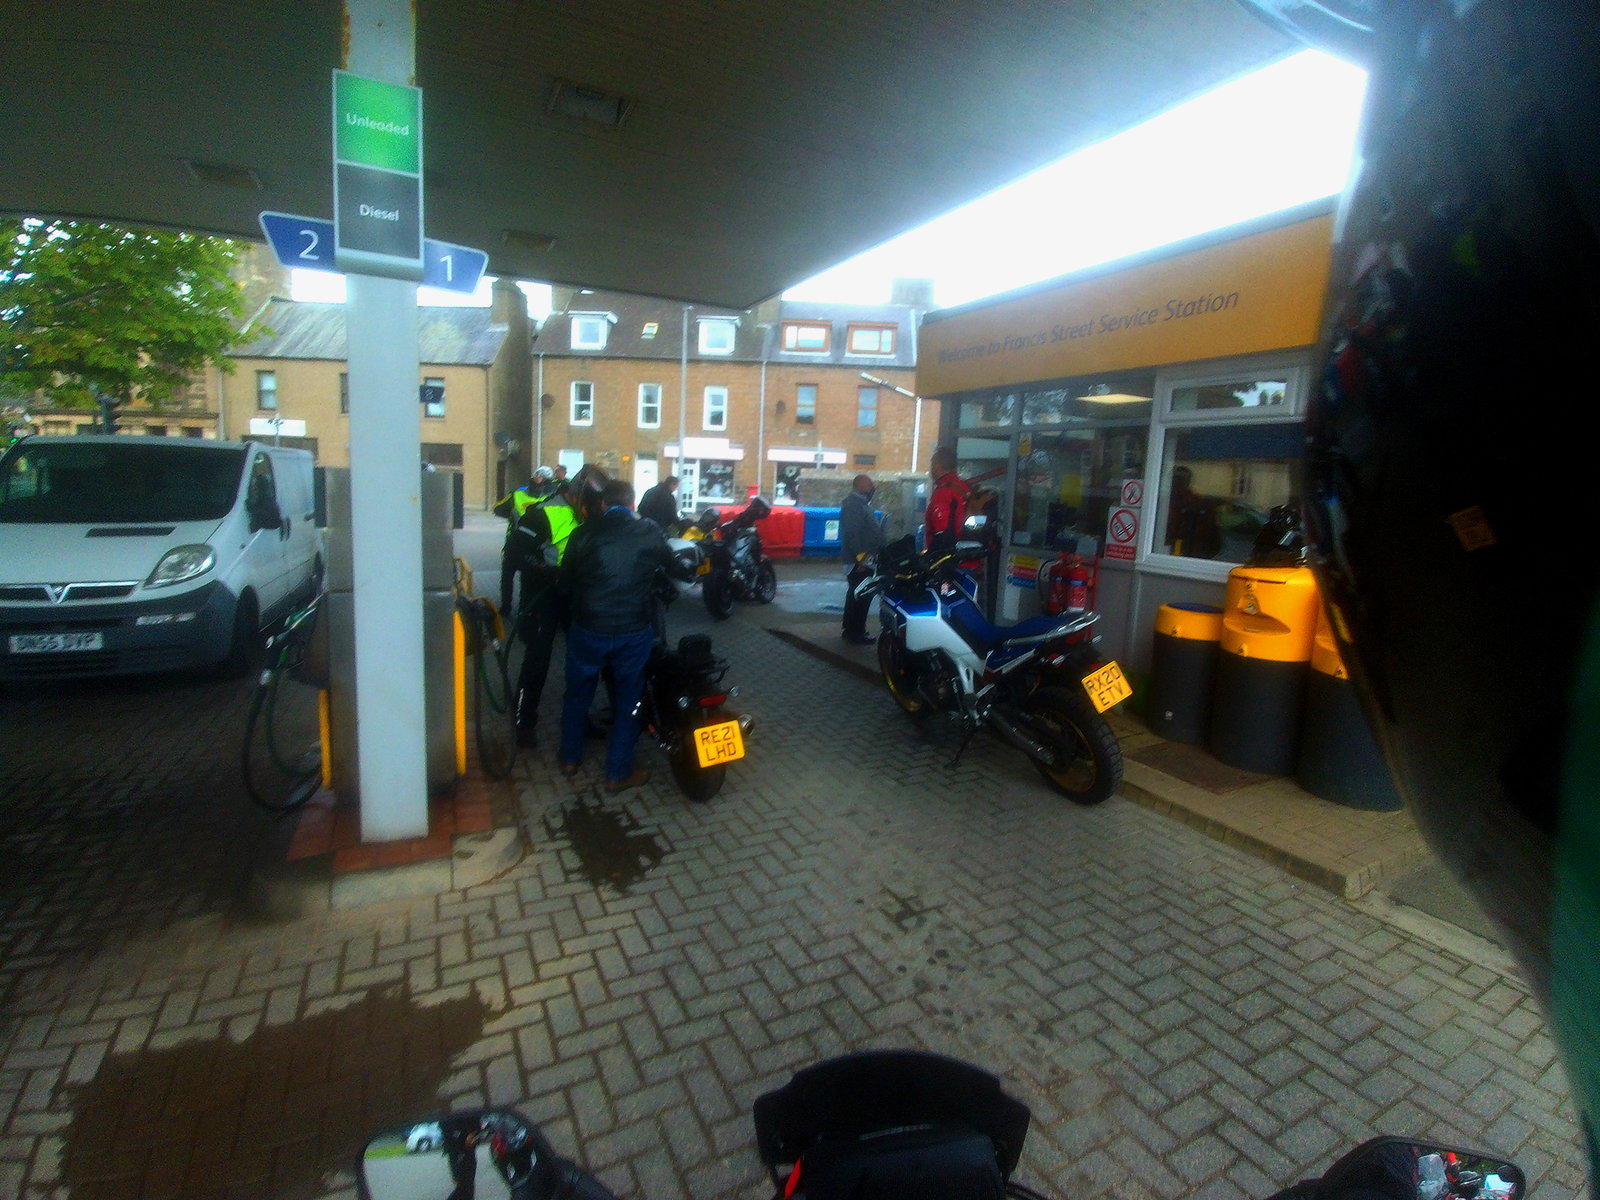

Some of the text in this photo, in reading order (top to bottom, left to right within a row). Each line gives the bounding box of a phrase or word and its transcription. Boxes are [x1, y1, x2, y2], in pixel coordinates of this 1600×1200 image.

[345, 112, 409, 136] Unleaded
[359, 204, 399, 221] Diesel
[298, 229, 320, 260] 2
[439, 254, 453, 282] 1
[987, 340, 1001, 354] to
[1002, 331, 1047, 351] Francis
[1050, 319, 1093, 343] Street
[1099, 309, 1159, 335] Service
[1164, 291, 1240, 322] Station
[1085, 665, 1121, 695] RX20
[1098, 682, 1123, 706] ETV
[701, 725, 735, 745] RE21
[706, 742, 736, 761] LHD
